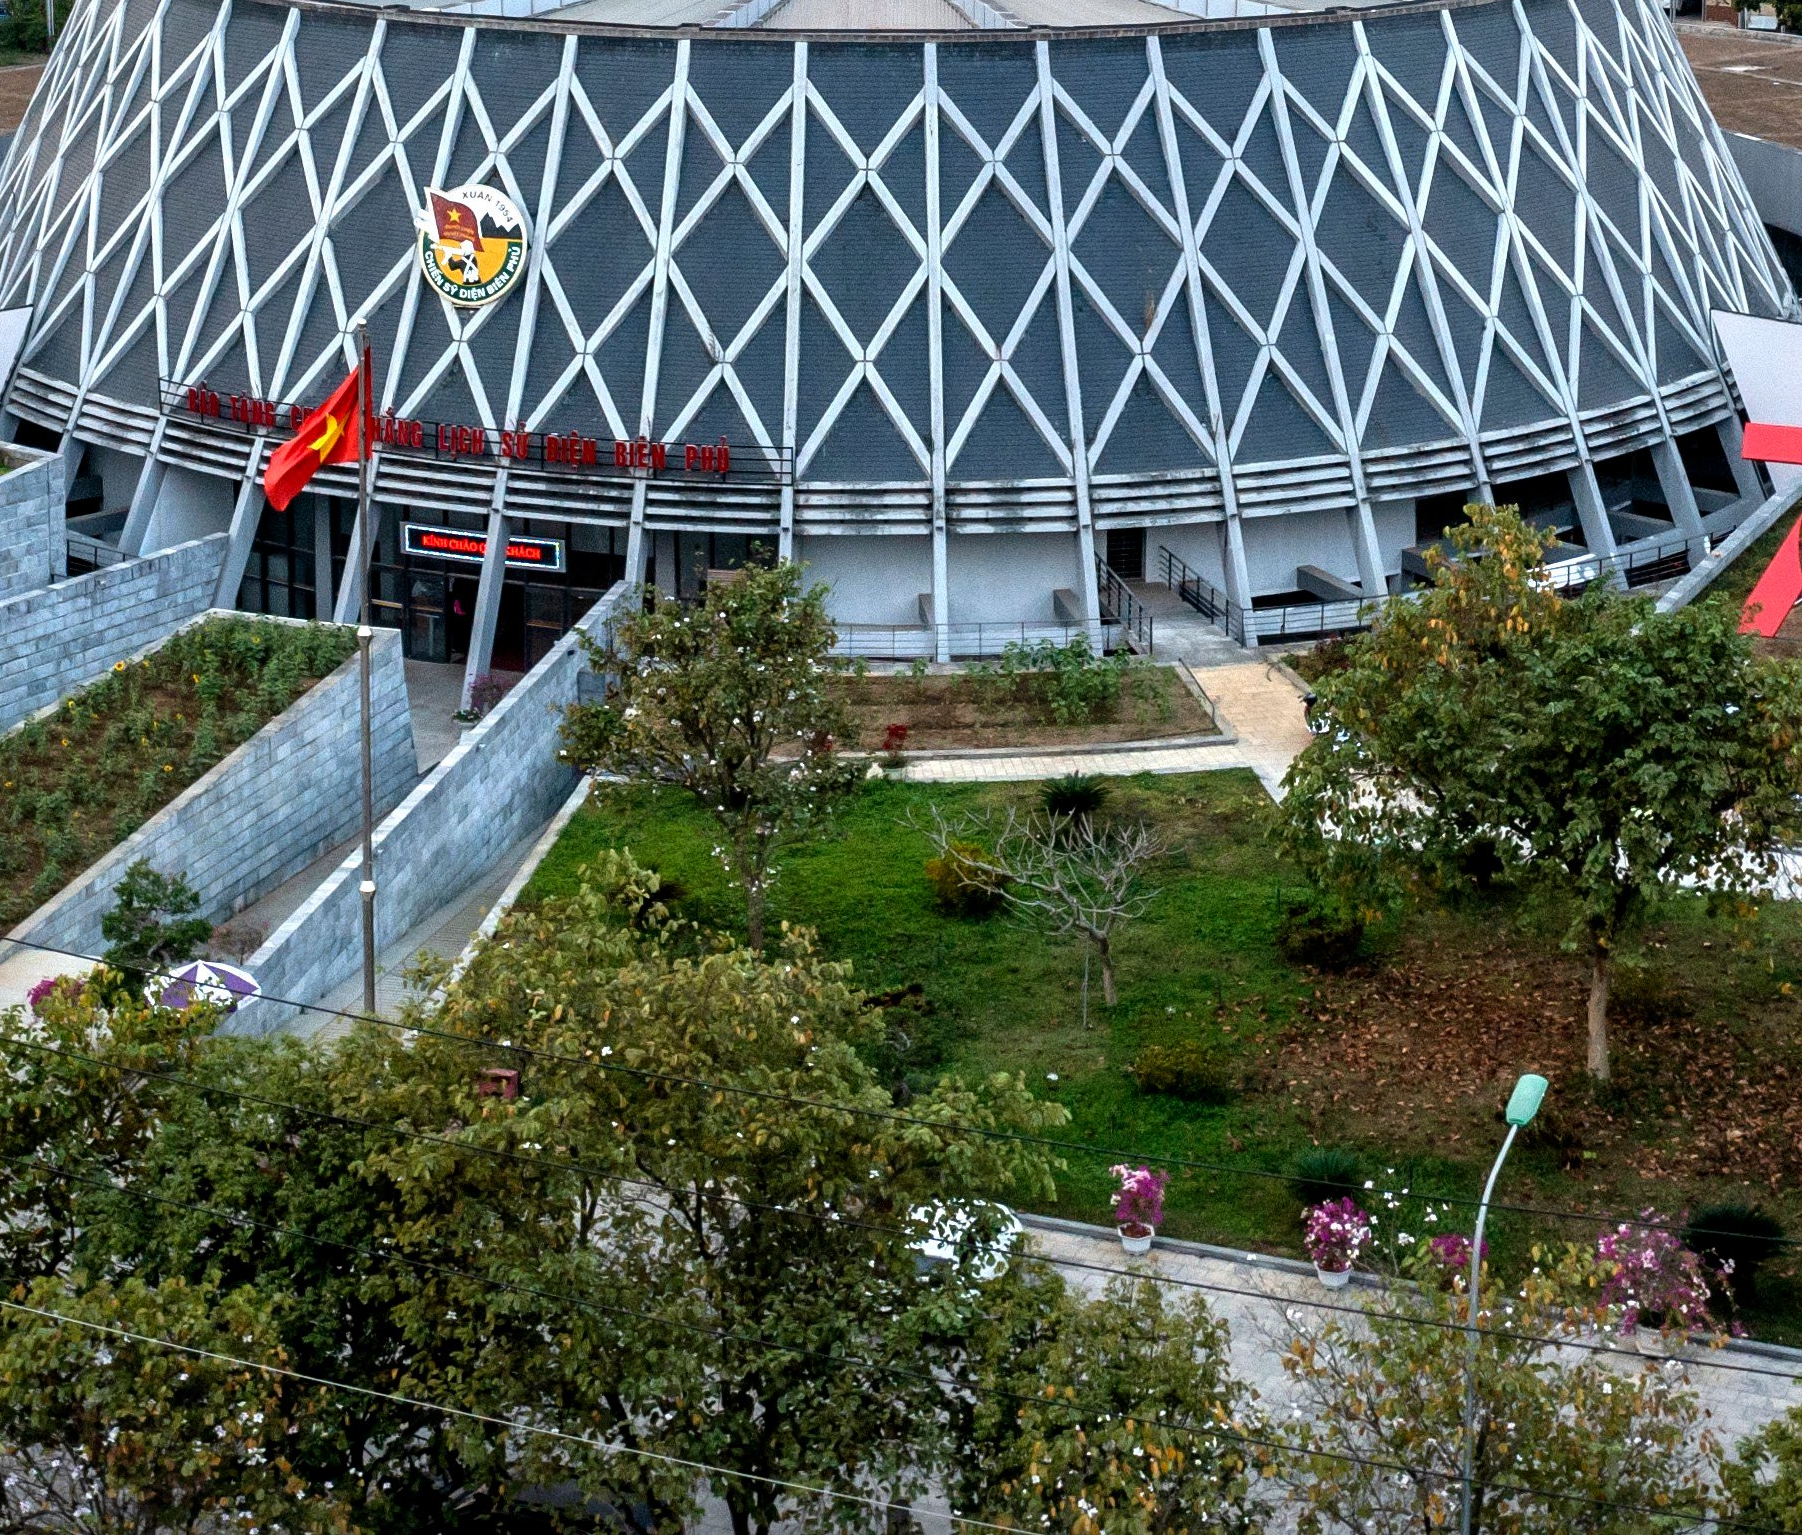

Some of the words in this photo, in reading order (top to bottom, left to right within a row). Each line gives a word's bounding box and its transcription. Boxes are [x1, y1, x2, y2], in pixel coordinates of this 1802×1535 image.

[495, 200, 513, 222] 1954
[438, 422, 485, 459] LỊCH
[614, 434, 667, 471] BIÊN
[685, 434, 730, 473] PHỦ
